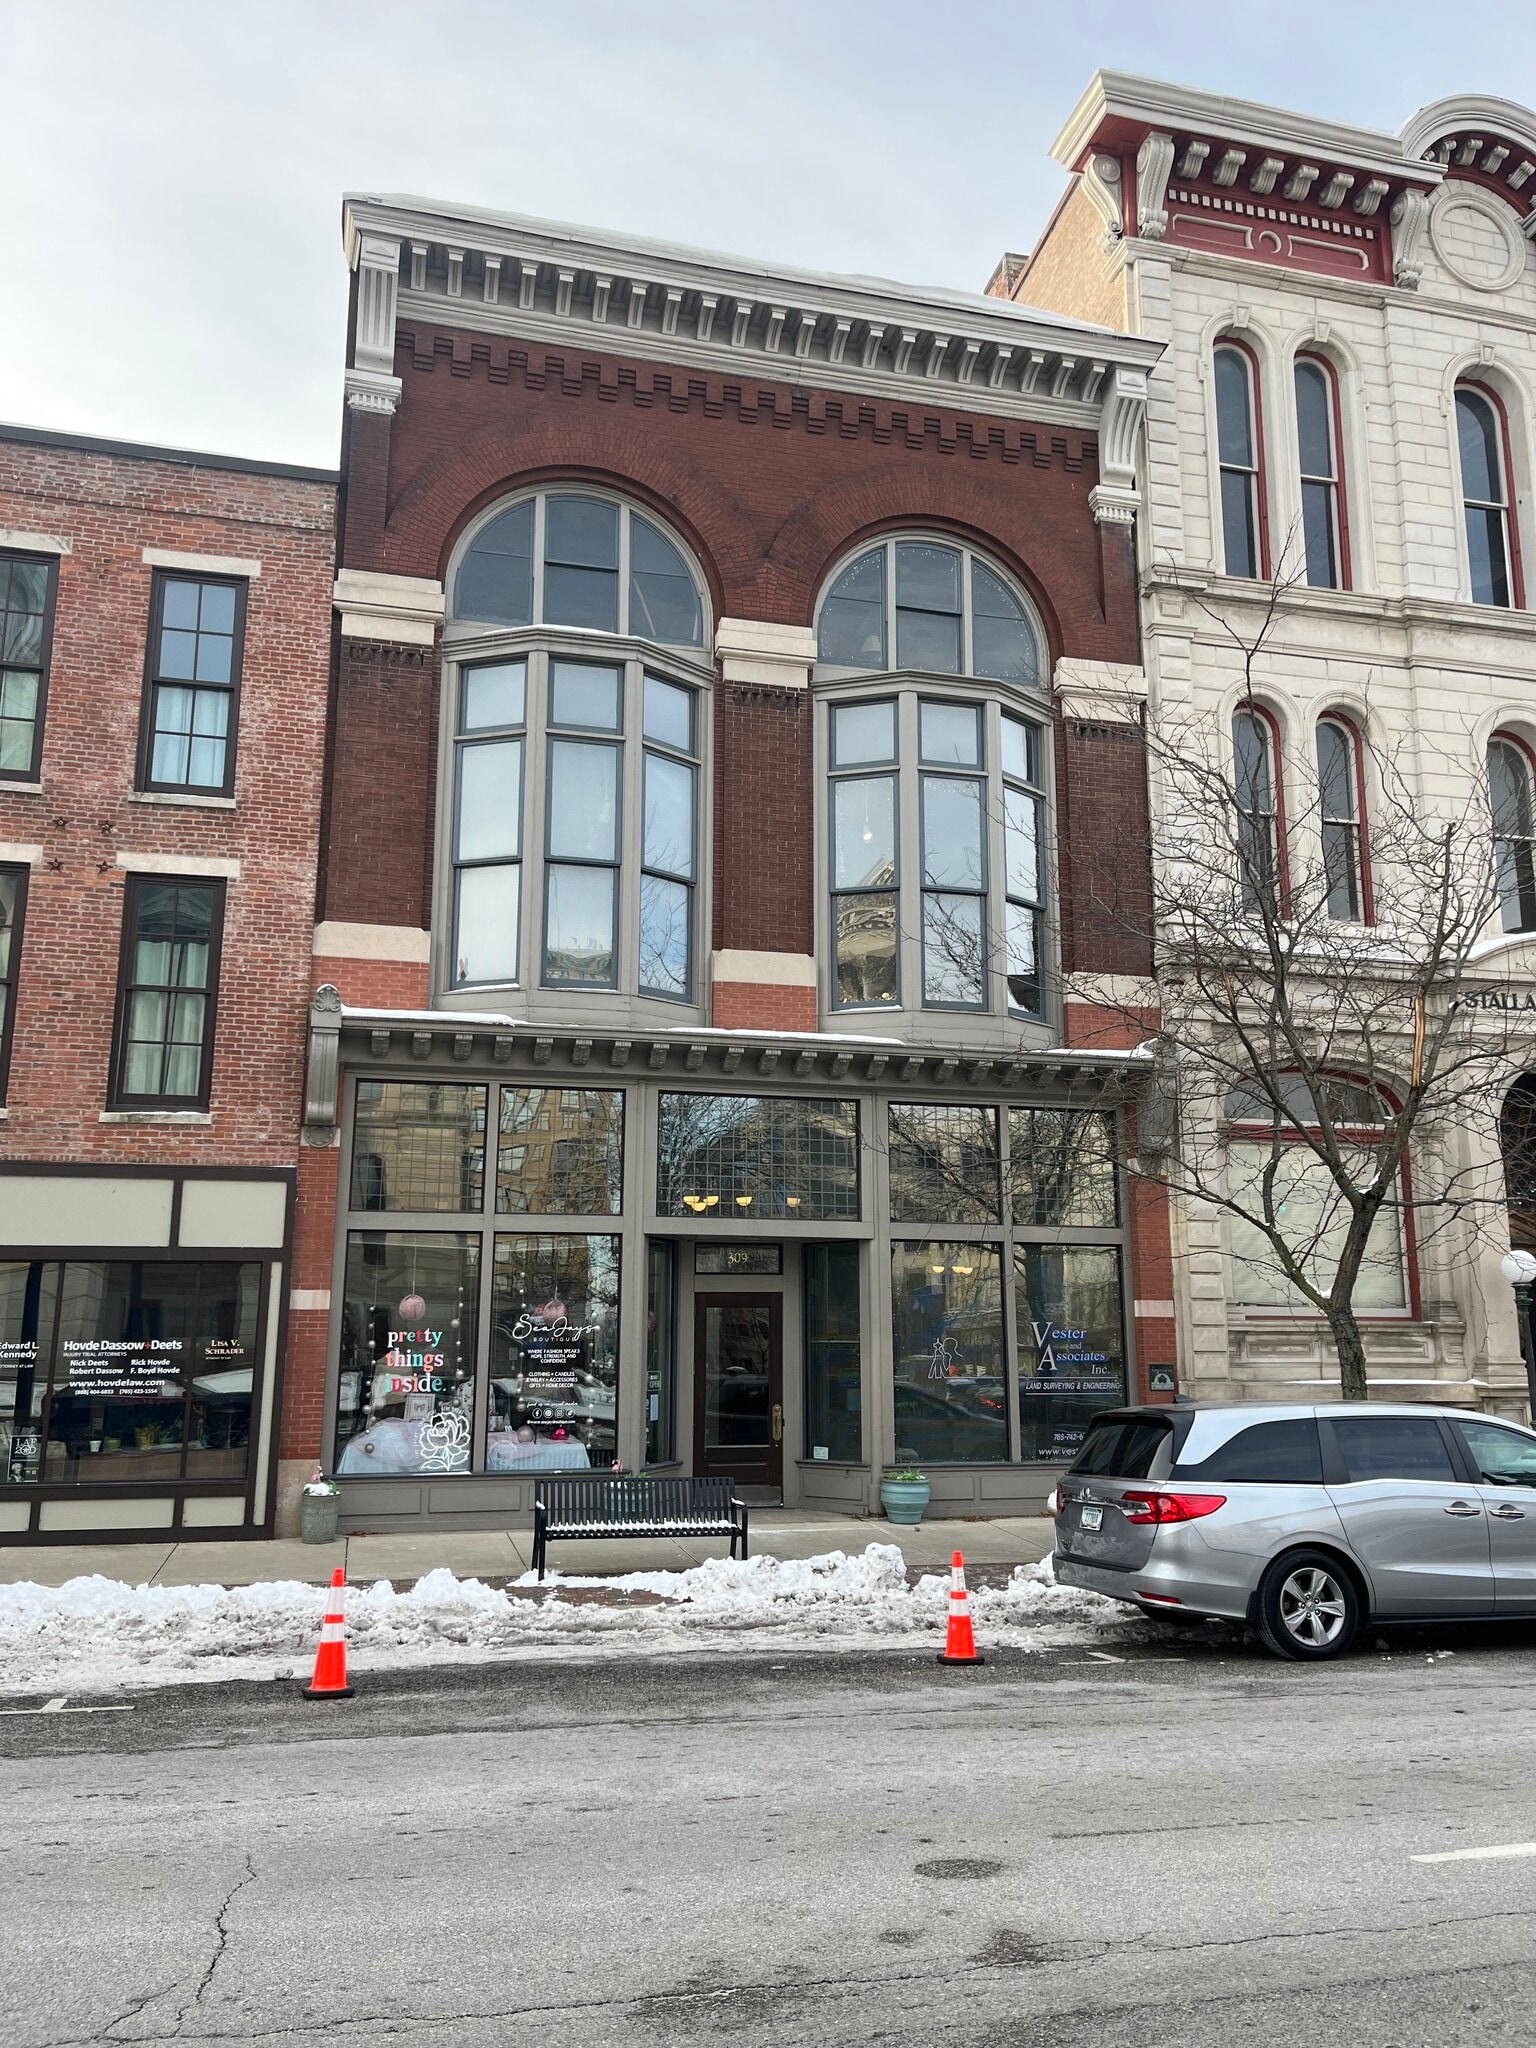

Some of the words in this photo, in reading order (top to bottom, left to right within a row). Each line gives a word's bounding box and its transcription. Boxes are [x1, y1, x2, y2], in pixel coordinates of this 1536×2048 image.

[727, 1252, 748, 1264] 309
[387, 1327, 443, 1348] pretty
[1030, 1321, 1087, 1348] Vester
[31, 1341, 40, 1349] L.
[64, 1341, 99, 1351] Hovde
[230, 1339, 240, 1347] V.
[385, 1347, 444, 1373] things
[1036, 1344, 1106, 1371] Associates
[1091, 1364, 1110, 1374] Inc.
[69, 1379, 165, 1388] www.hovdelaw.com
[384, 1372, 447, 1393] inside.
[1025, 1382, 1042, 1390] LAND
[1042, 1382, 1075, 1390] SURVEYING
[1076, 1382, 1082, 1390] &
[1082, 1382, 1121, 1390] ENGINEERING
